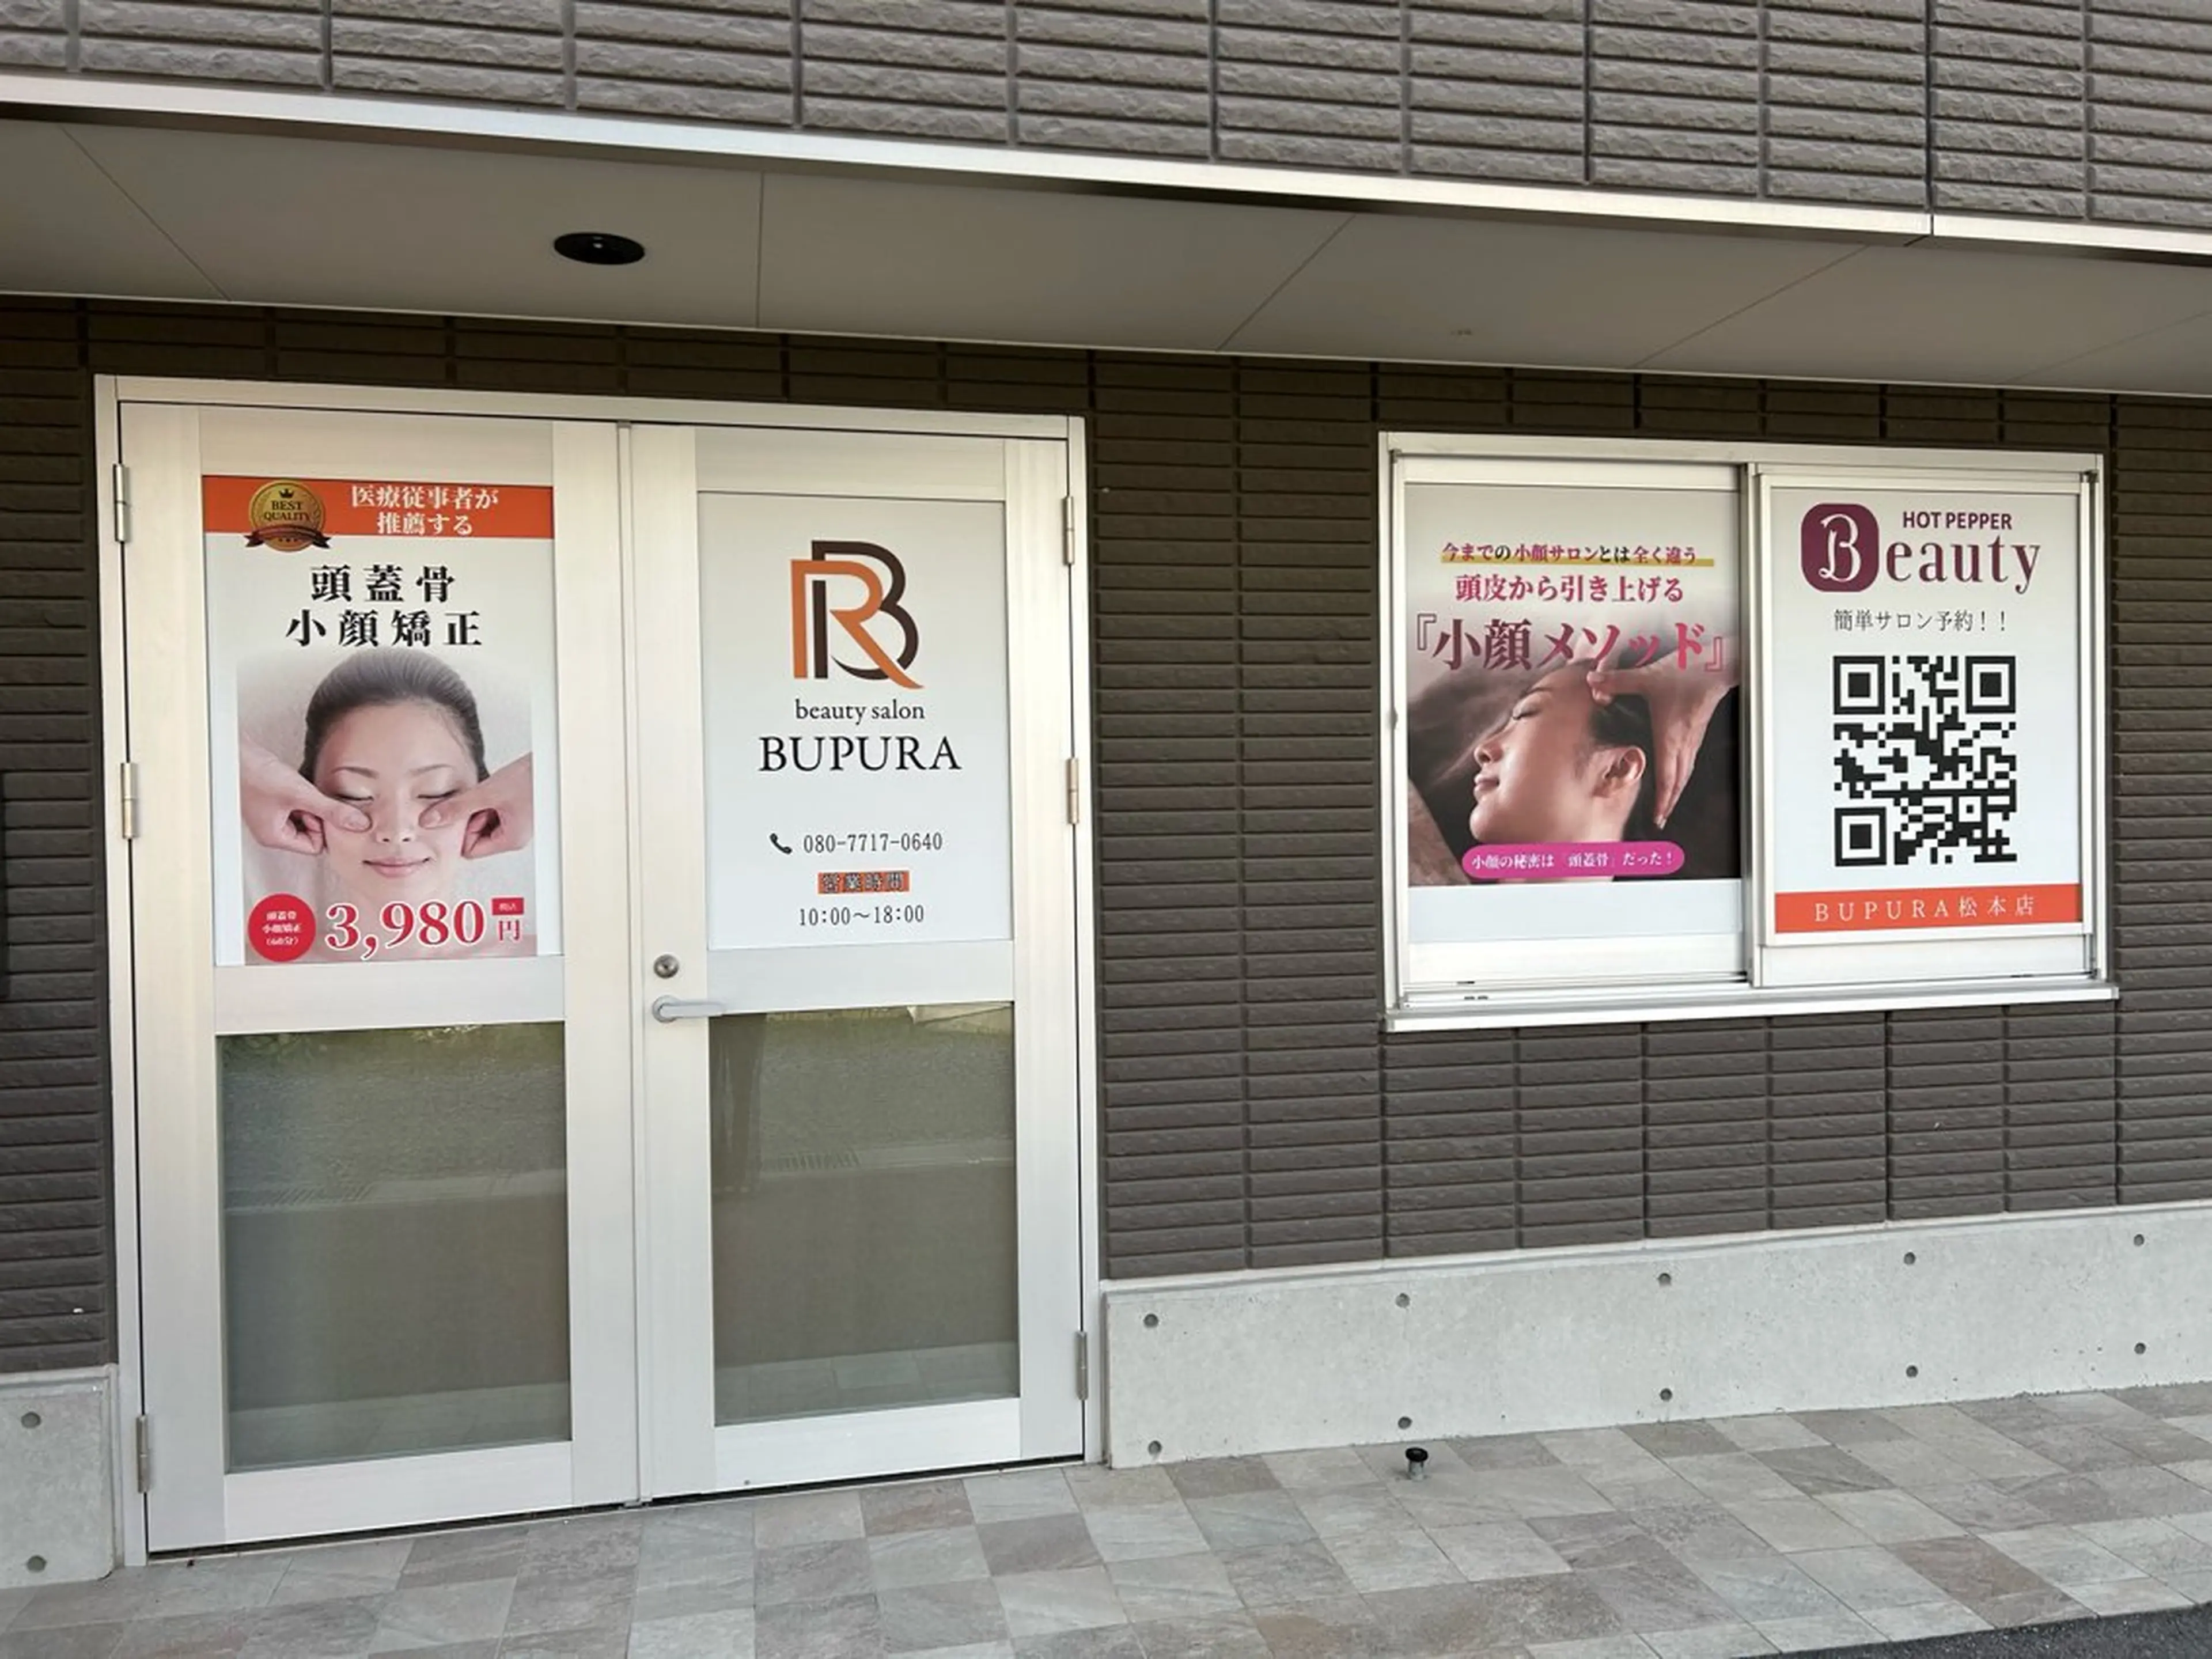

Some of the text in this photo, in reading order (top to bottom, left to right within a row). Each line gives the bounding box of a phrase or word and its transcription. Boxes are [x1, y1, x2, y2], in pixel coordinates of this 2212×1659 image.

[271, 500, 304, 510] BEST
[351, 484, 499, 509] 医療従事者が
[263, 512, 313, 521] QUALITY
[377, 512, 472, 536] 推薦する
[1902, 511, 2012, 531] HOT PEPPER
[1442, 541, 1697, 565] 今までの小顔サロンとは全く違う
[310, 564, 456, 603] 頭蓋骨
[1456, 574, 1684, 603] 頭皮から引き上げる
[285, 609, 483, 647] 小顔矯正
[1834, 608, 2006, 632] 簡単サロン予約！！
[1416, 613, 1726, 672] 『小顔メソッド』
[795, 699, 925, 725] beauty salon
[759, 736, 963, 772] BUPURA
[803, 833, 943, 853] 080-7717-0640
[325, 899, 486, 960] 3,980
[499, 919, 520, 941] 円
